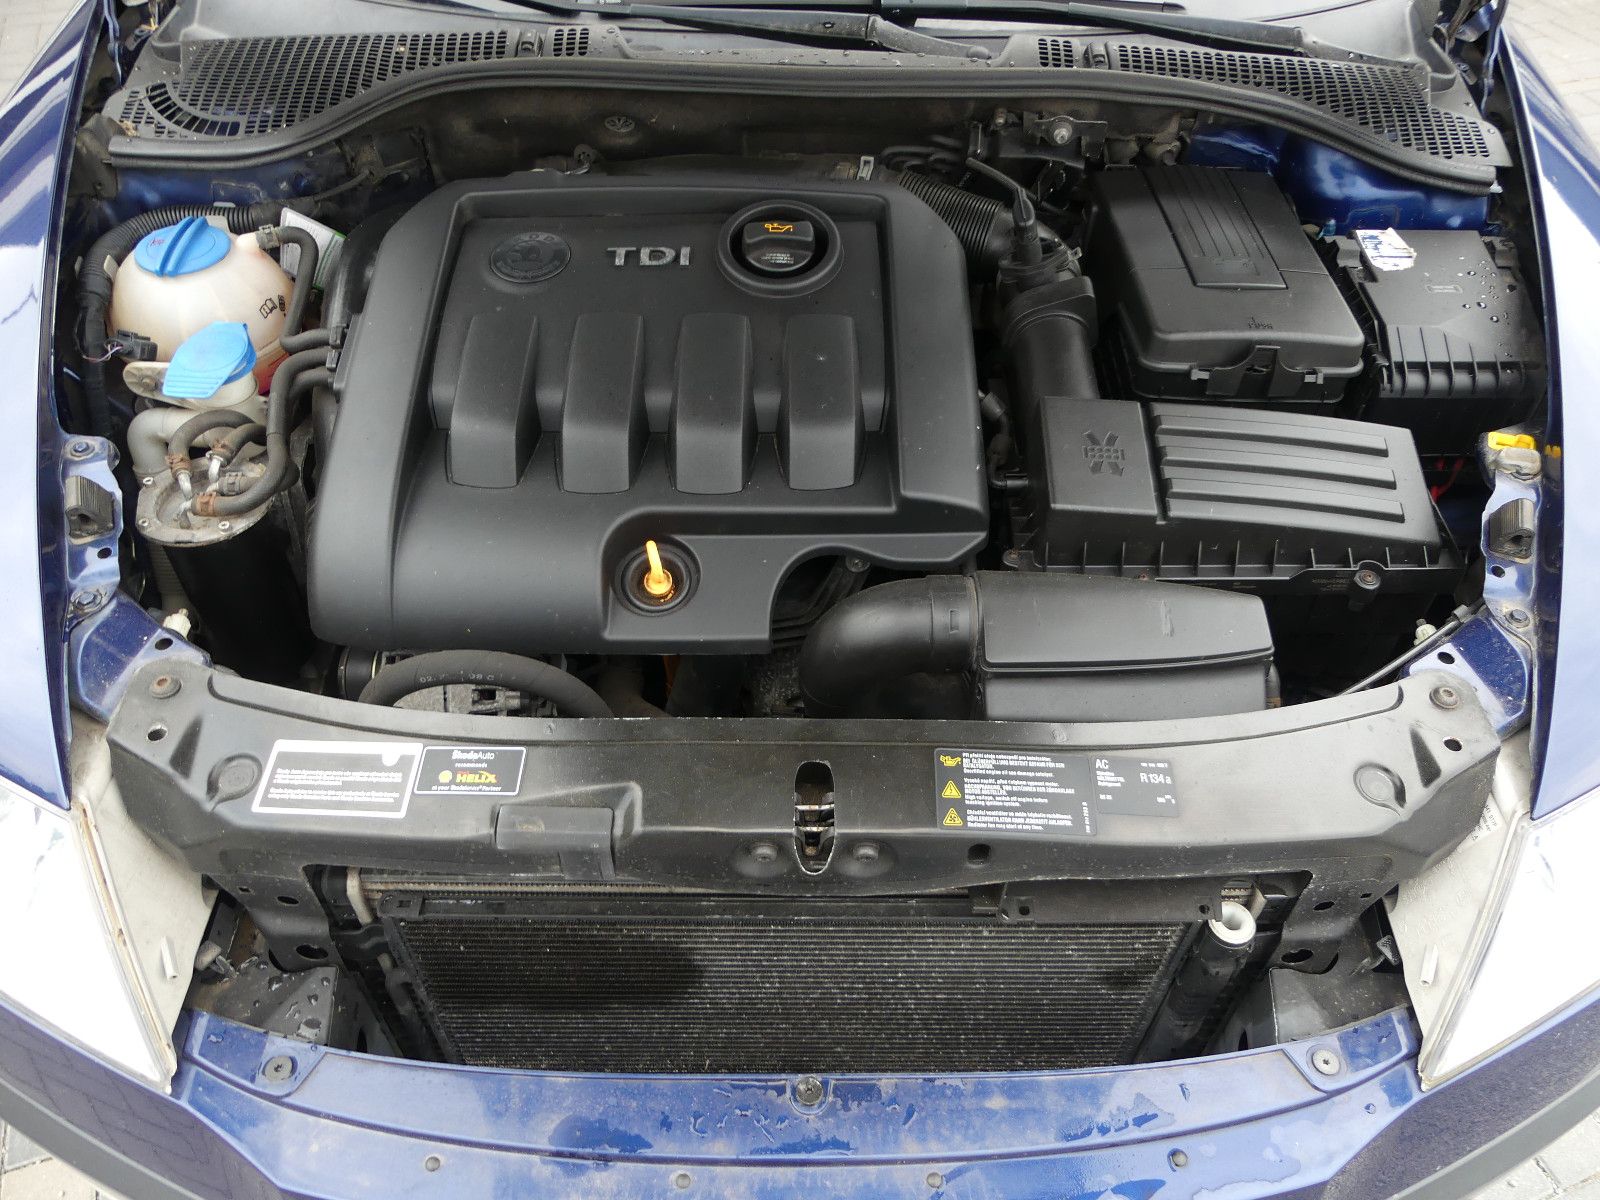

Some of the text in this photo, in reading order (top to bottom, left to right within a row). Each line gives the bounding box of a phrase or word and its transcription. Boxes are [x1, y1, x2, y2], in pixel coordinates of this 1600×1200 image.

[607, 246, 690, 266] TDI
[1096, 759, 1109, 769] AC
[456, 772, 497, 783] HELIX
[1140, 772, 1149, 783] R
[1148, 773, 1165, 784] 134
